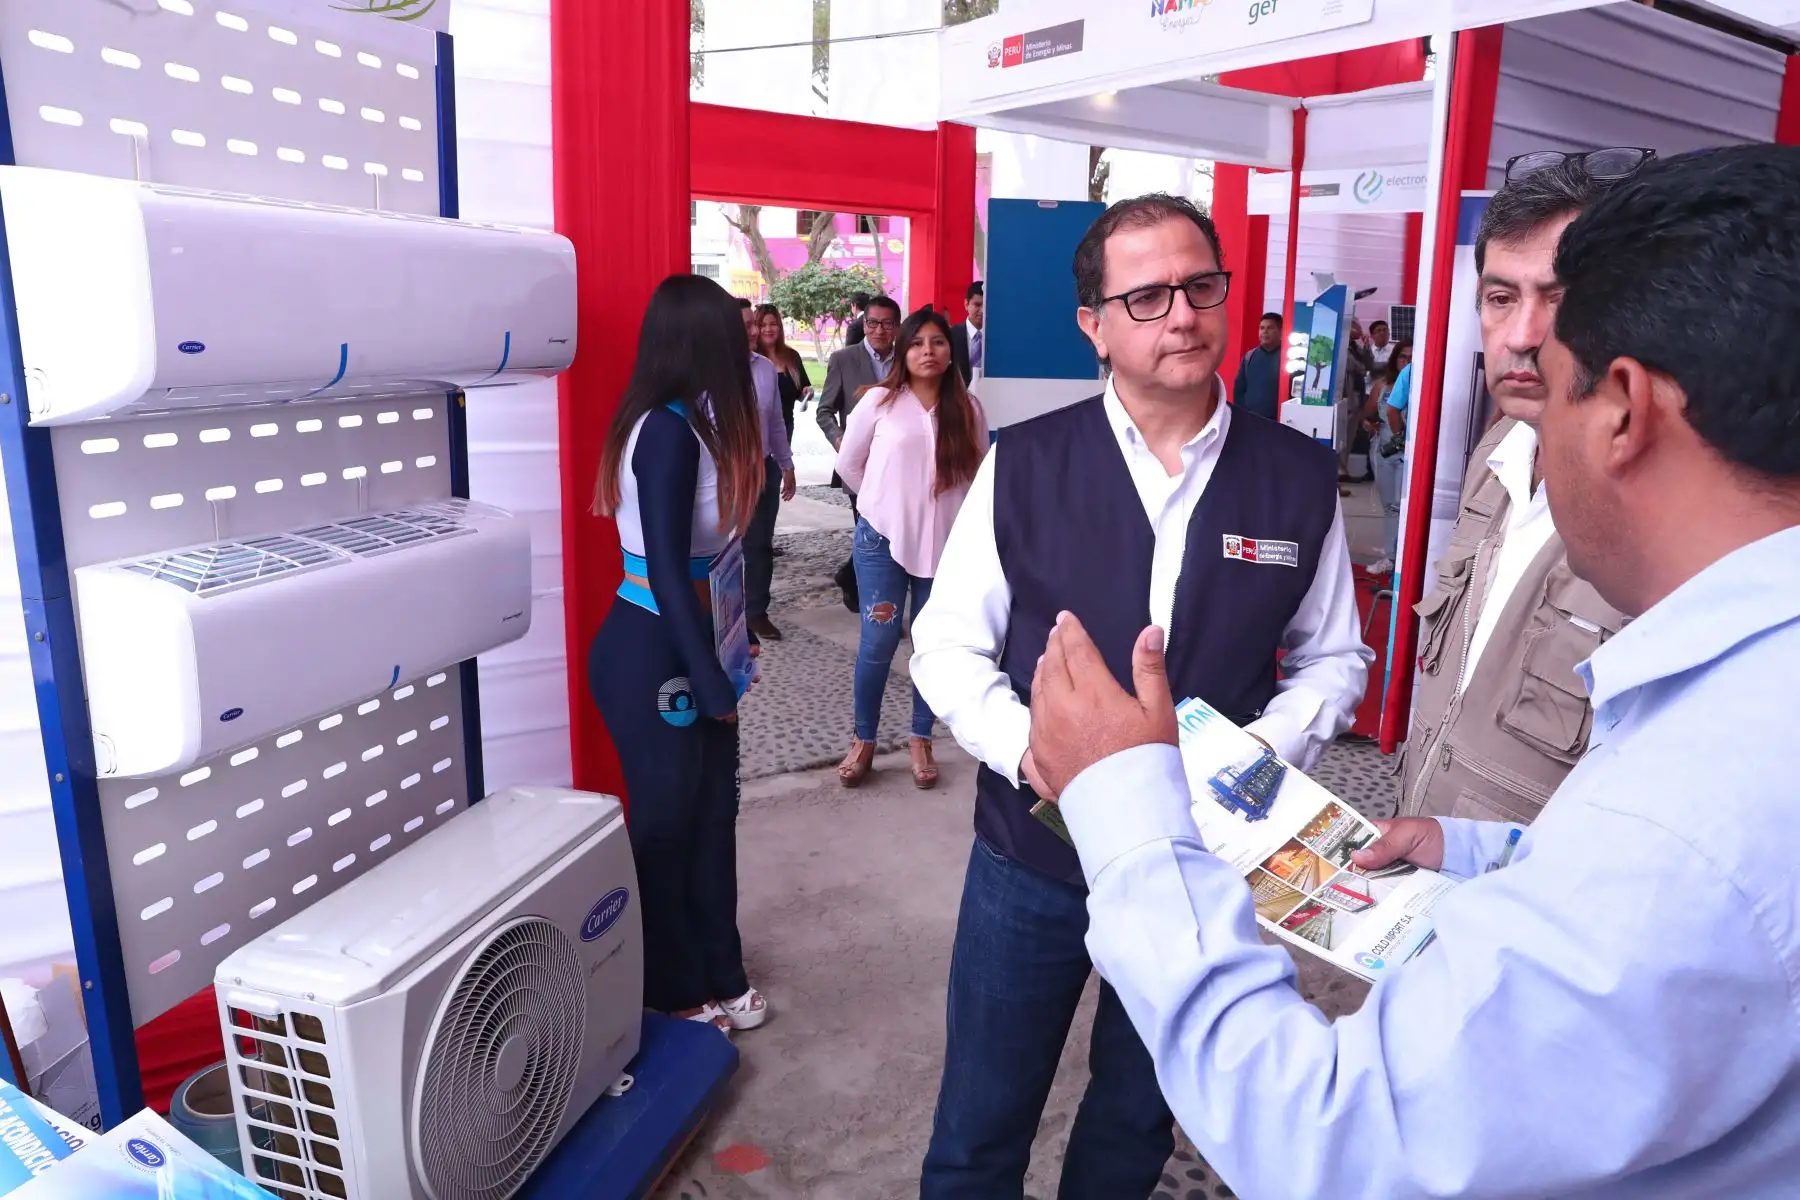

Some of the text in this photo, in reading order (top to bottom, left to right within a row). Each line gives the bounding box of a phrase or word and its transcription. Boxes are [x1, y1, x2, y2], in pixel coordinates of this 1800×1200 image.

[1025, 40, 1052, 52] Ministerio
[1025, 52, 1033, 60] de
[1056, 42, 1073, 53] Minas
[1259, 544, 1292, 553] Ministerio
[586, 894, 625, 934] Carrier
[1371, 939, 1390, 956] COLD
[1384, 921, 1406, 942] IMPORT
[130, 1141, 162, 1165] Carrier
